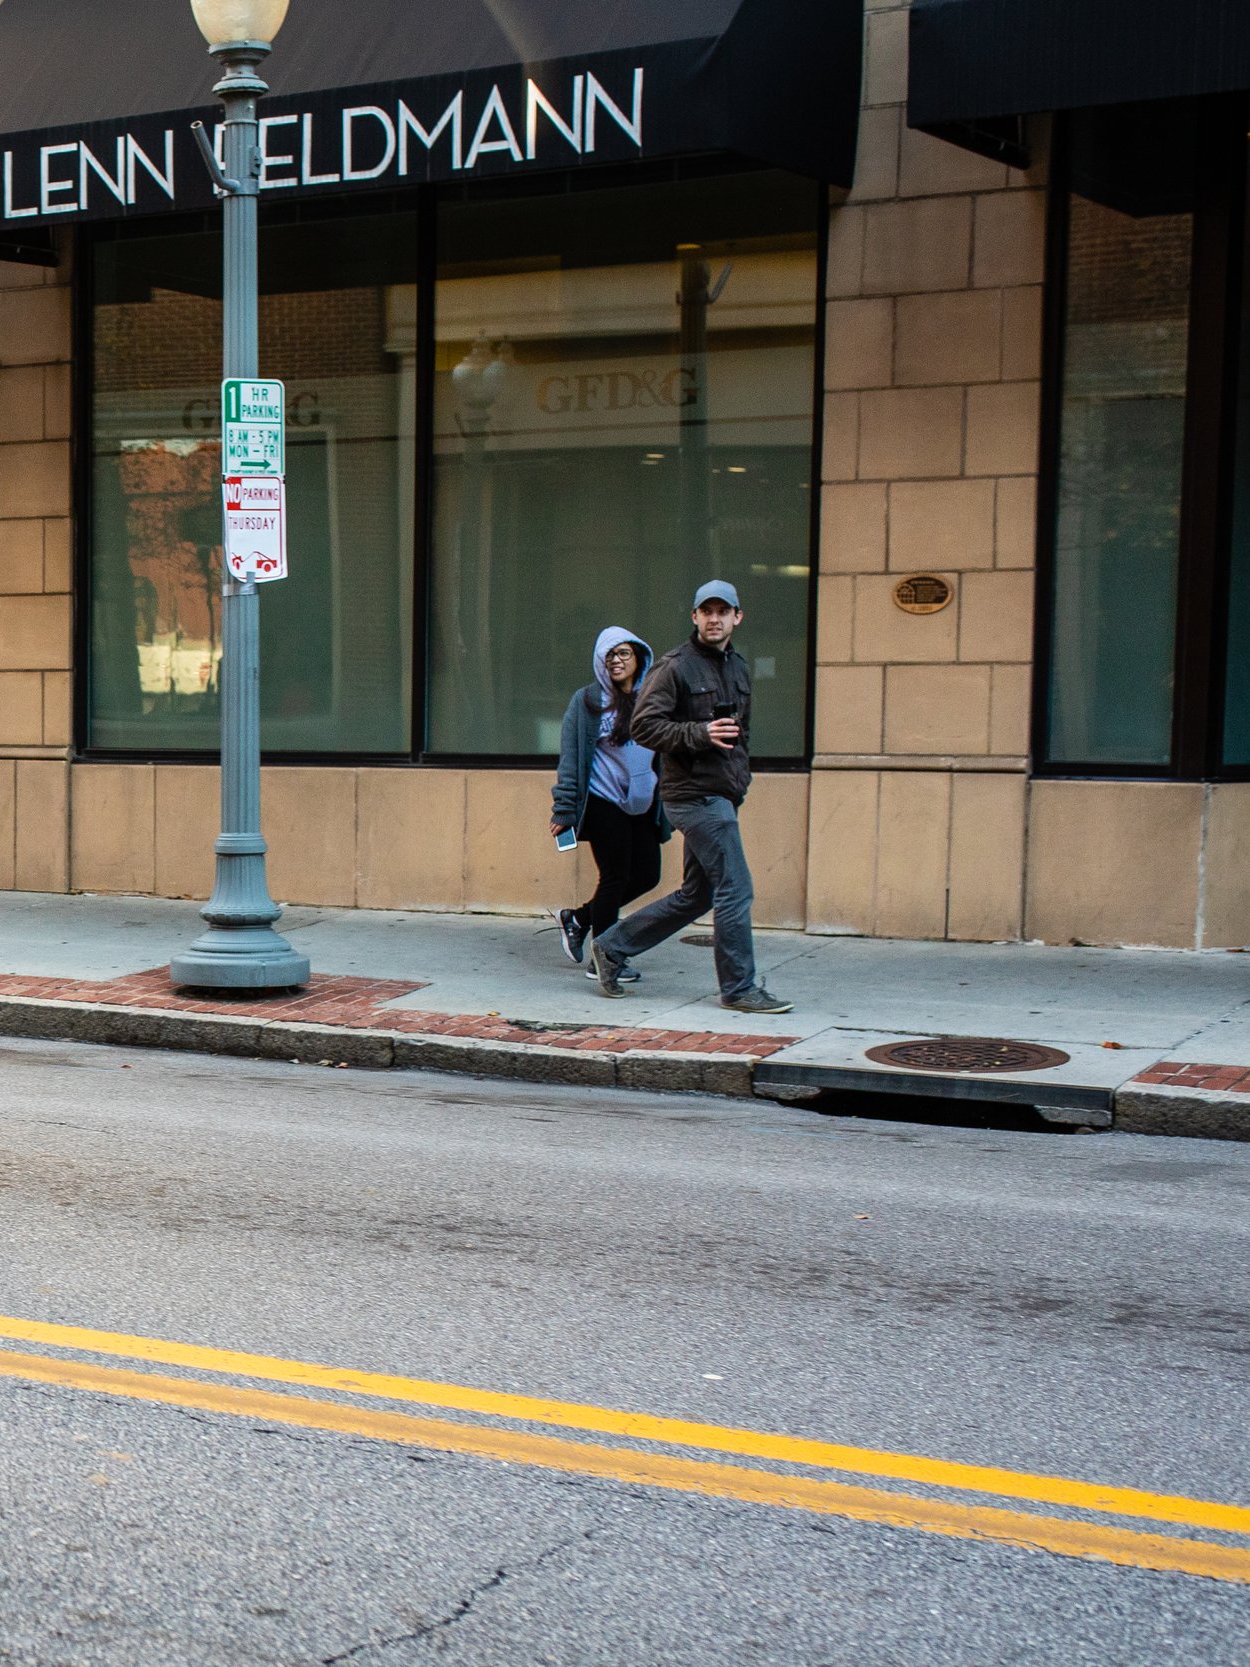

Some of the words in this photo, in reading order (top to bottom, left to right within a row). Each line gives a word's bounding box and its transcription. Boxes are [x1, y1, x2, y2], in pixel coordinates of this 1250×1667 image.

[536, 367, 699, 414] GFD&G
[229, 386, 237, 418] 1
[251, 387, 269, 401] HR
[242, 404, 280, 419] PARKING
[229, 429, 234, 443] 8
[238, 430, 249, 443] AM
[259, 430, 264, 444] 5
[267, 430, 279, 443] PM
[229, 444, 249, 458] MON
[264, 444, 279, 458] FRI
[225, 483, 241, 503] NO
[242, 488, 279, 501] PARKING
[229, 517, 276, 530] THURSDAY
